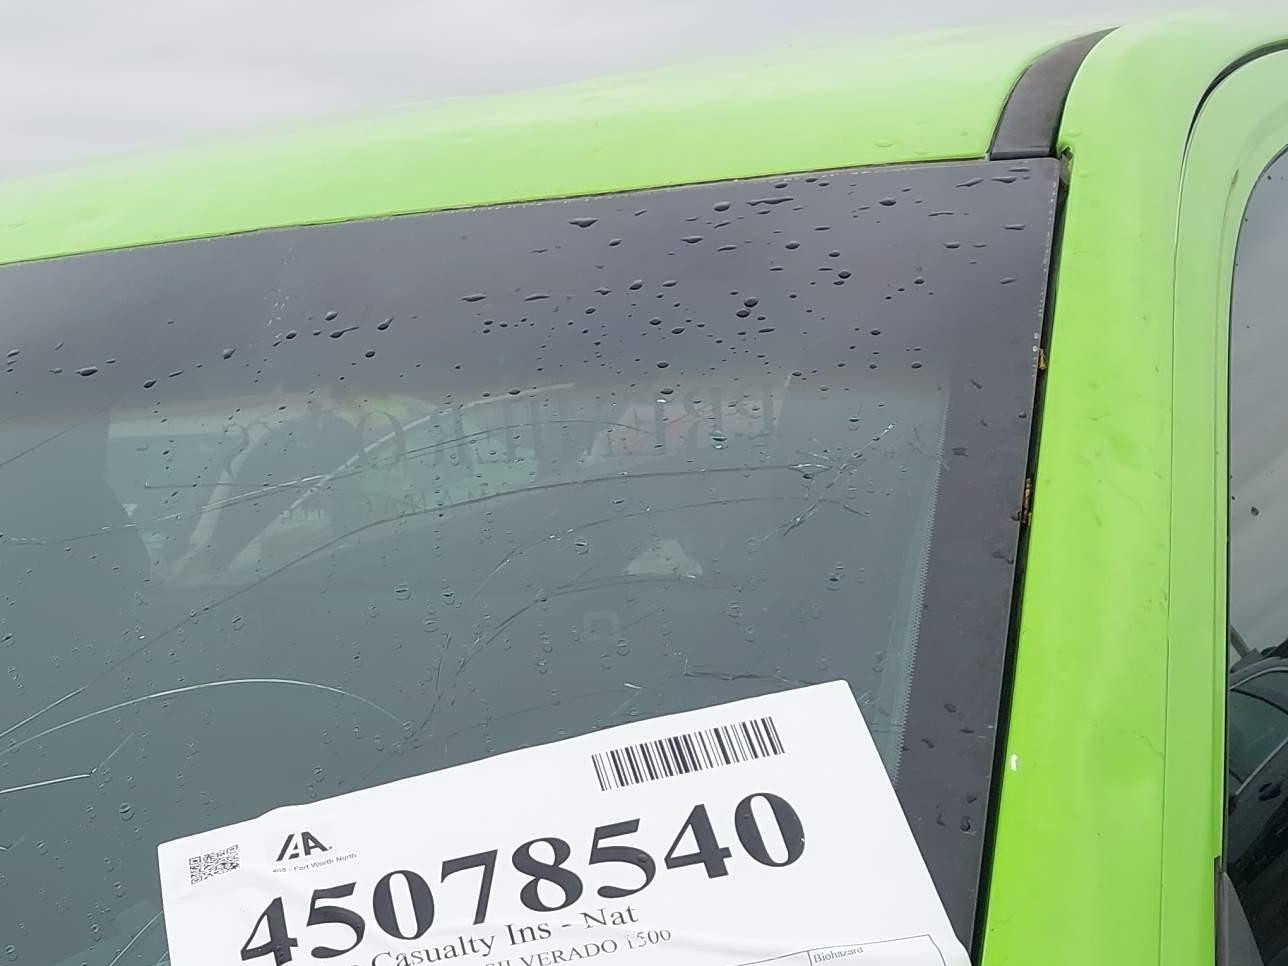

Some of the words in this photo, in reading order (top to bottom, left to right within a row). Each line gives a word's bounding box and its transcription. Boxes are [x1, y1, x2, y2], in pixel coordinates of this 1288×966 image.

[310, 859, 334, 868] Worth
[335, 853, 358, 862] North
[505, 921, 552, 947] Ins
[580, 905, 639, 929] Nat
[626, 929, 671, 950] 1500
[813, 946, 864, 964] Biohazard
